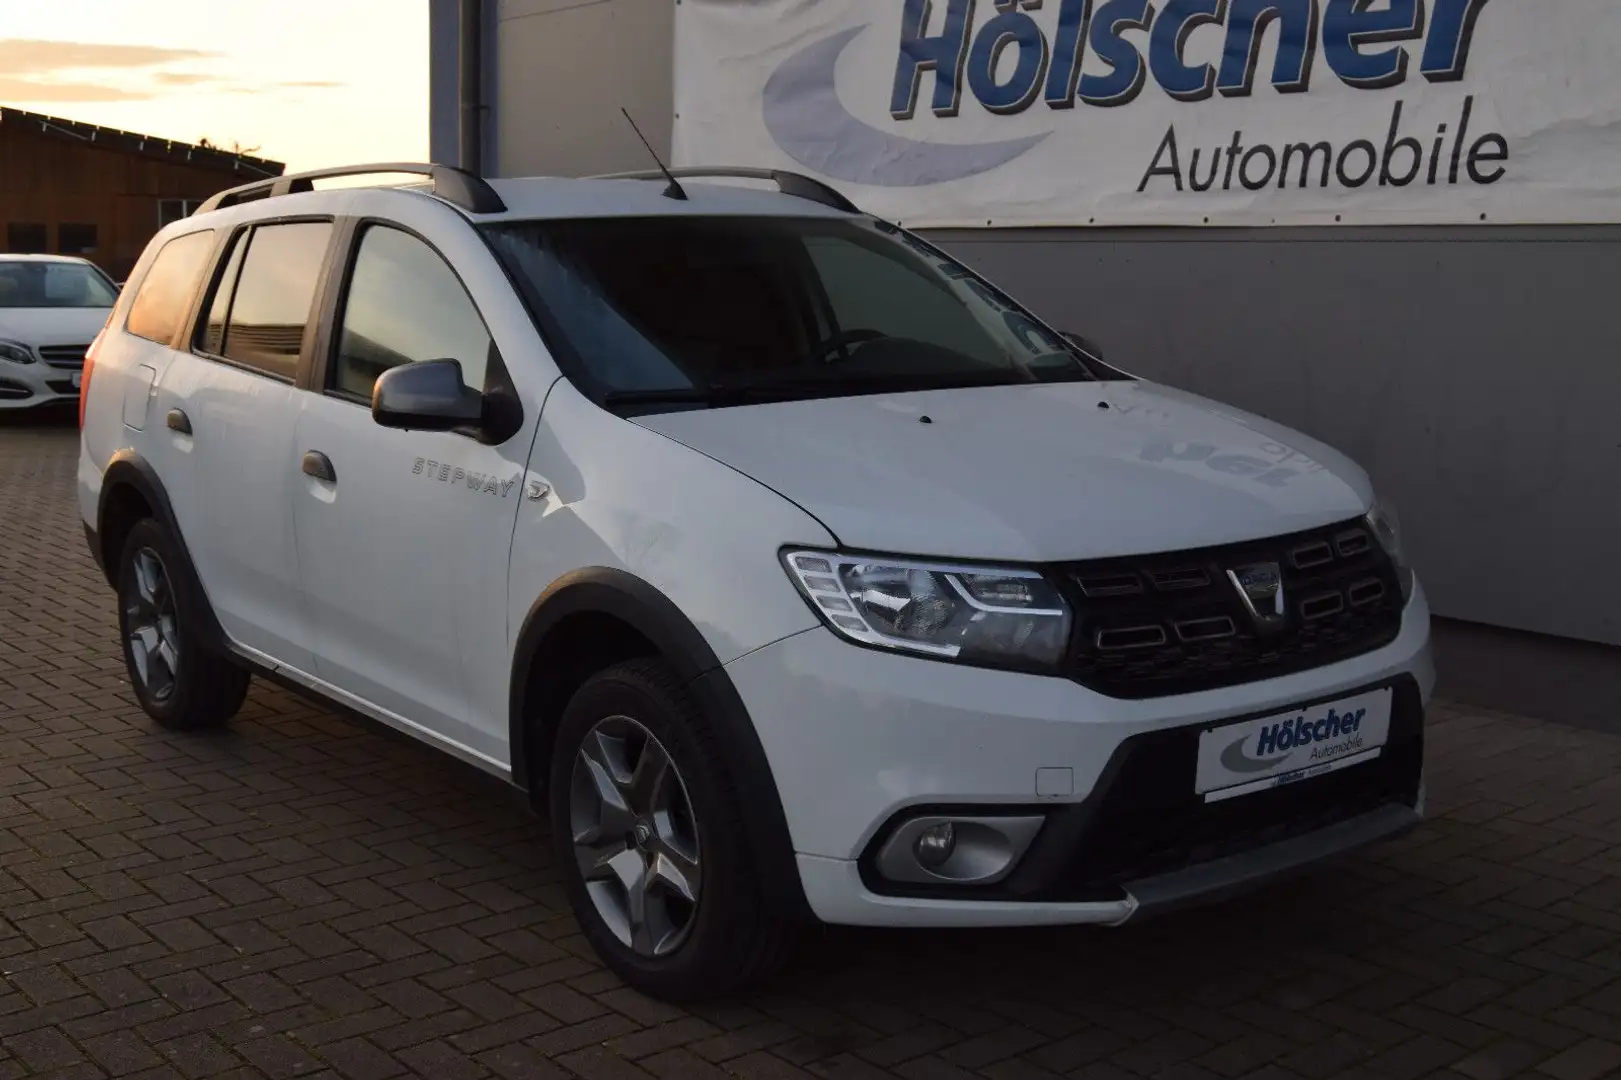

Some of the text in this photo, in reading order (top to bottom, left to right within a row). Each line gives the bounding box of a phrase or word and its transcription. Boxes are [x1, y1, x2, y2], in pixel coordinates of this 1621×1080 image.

[1136, 94, 1509, 192] Automobile
[412, 457, 515, 498] STEPWAY
[1256, 707, 1367, 756] Hölscher
[1309, 733, 1364, 760] Automobile
